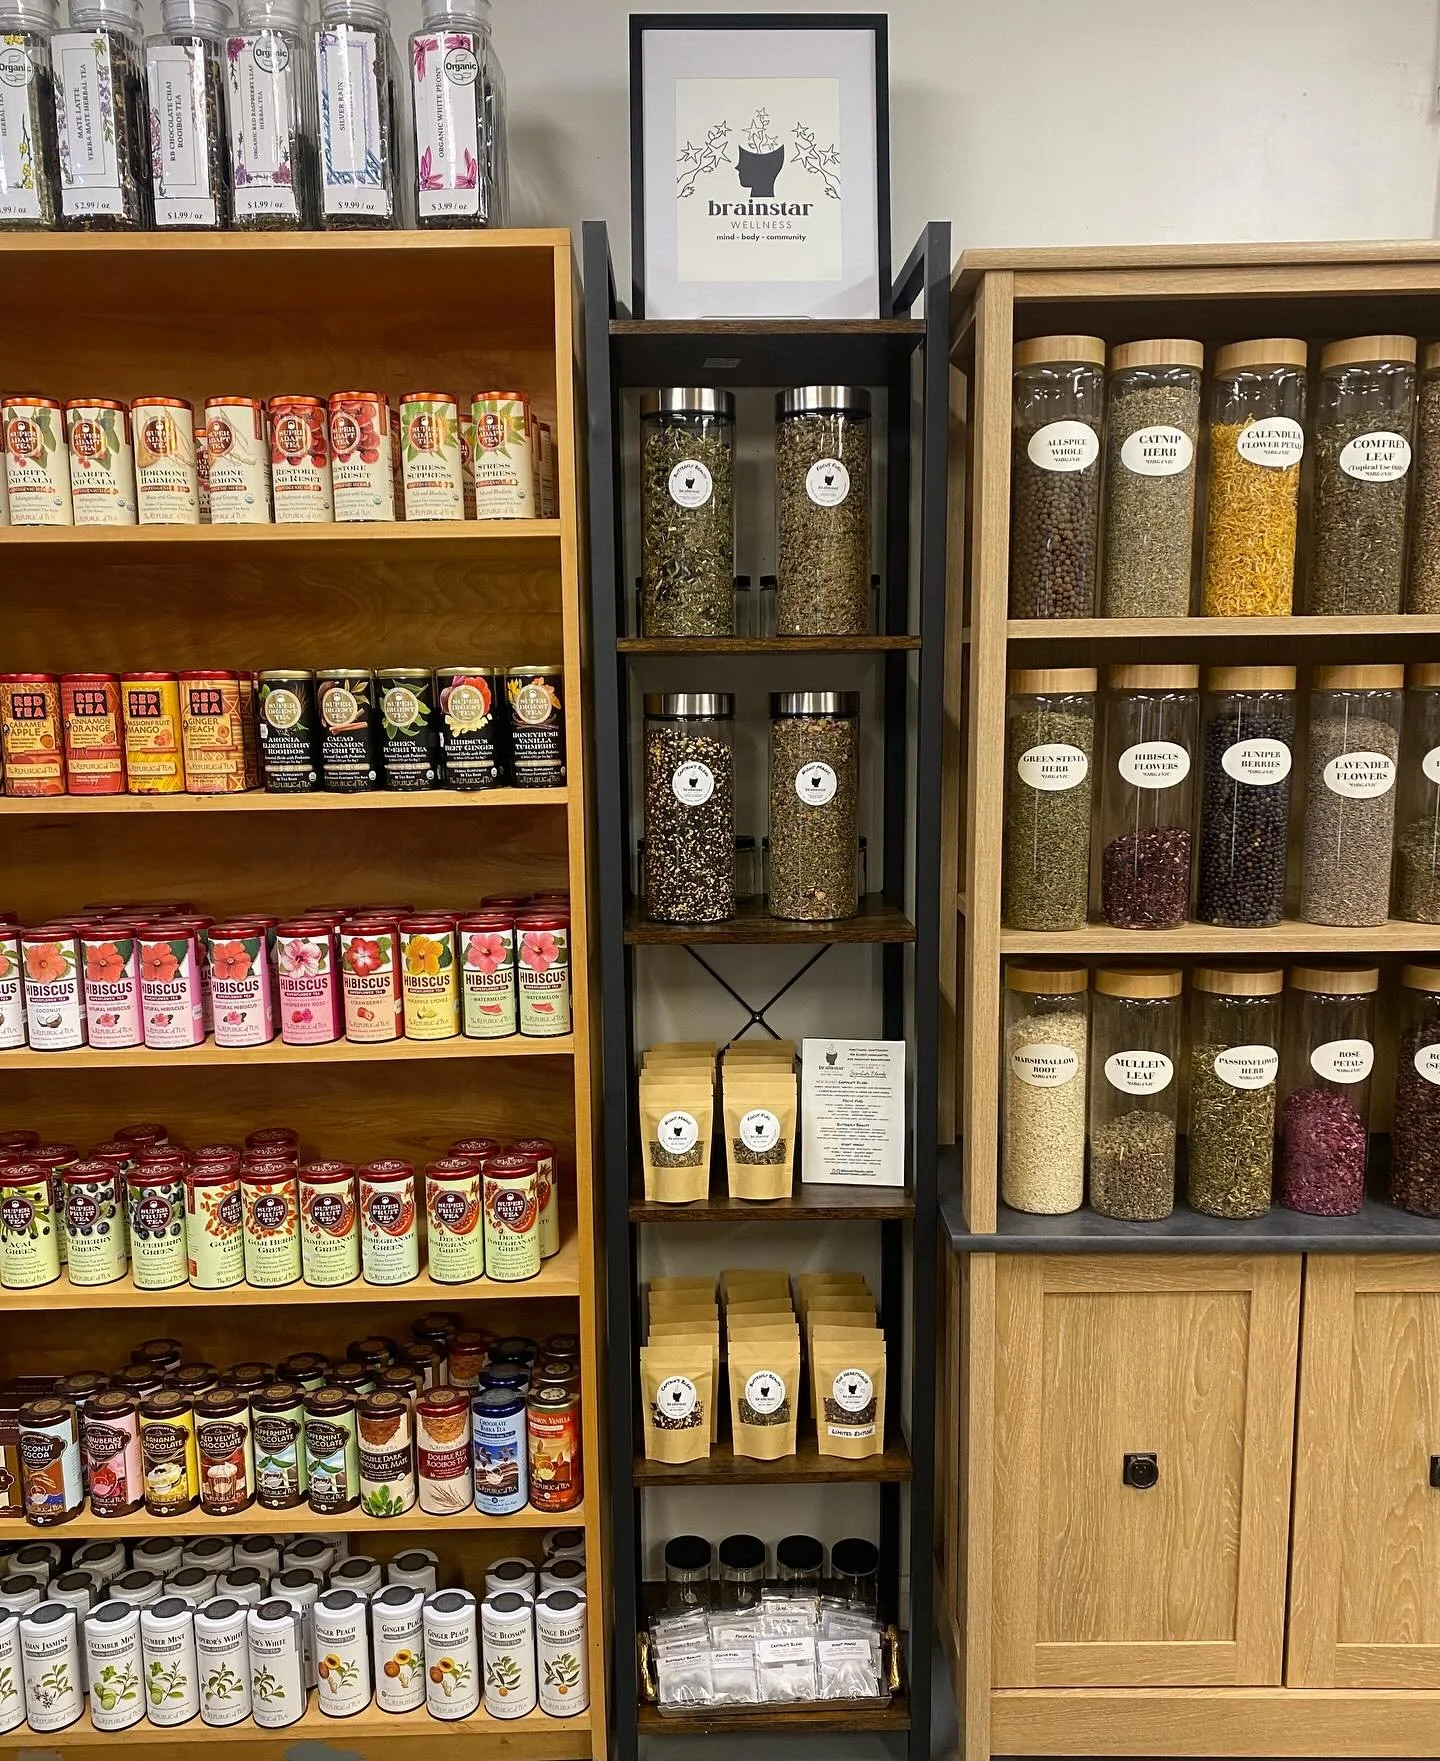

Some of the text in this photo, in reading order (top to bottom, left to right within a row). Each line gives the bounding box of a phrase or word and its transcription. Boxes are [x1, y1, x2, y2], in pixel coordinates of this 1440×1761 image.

[446, 62, 477, 71] Organic
[434, 67, 442, 92] PEONY
[74, 87, 82, 114] LATTE
[82, 81, 90, 113] HERBAL
[165, 81, 176, 162] RB CHOCOLATE CHAI
[176, 112, 184, 149] ROOIBOS
[437, 121, 445, 159] ORGANIC
[708, 199, 814, 216] brainstar
[731, 221, 792, 229] WELLNESS
[741, 233, 760, 242] body
[767, 234, 807, 242] community
[1139, 435, 1182, 444] CATNIP
[1247, 430, 1301, 440] CALENDULA
[1047, 439, 1088, 447] ALLSPICE
[1241, 441, 1280, 449] FLOWER
[1353, 439, 1405, 449] COMFREY
[1051, 448, 1083, 456] WHOLE
[1143, 448, 1177, 457] HERB
[1366, 452, 1395, 461] LEAF
[407, 471, 452, 479] SUPPRESS
[141, 477, 189, 485] HARMONY
[13, 695, 43, 706] RED
[75, 692, 105, 703] RED
[130, 694, 159, 704] RED
[191, 692, 220, 702] RED
[14, 706, 44, 717] TEA
[76, 704, 106, 714] TEA
[130, 705, 160, 715] TEA
[192, 703, 221, 714] TEA
[10, 728, 41, 737] APPLE
[1055, 755, 1085, 763] STEVIA
[1134, 753, 1179, 761] HIBISCUS
[1241, 751, 1281, 759] JUNIPER
[1042, 765, 1069, 773] HERB
[1134, 763, 1179, 771] FLOWERS
[1241, 760, 1281, 768] BERRIES
[1335, 761, 1390, 770] LAVENDER
[1337, 772, 1388, 781] FLOWERS
[404, 974, 450, 987] HIBISCUS
[466, 972, 512, 985] HIBISCUS
[520, 970, 566, 984] HIBISCUS
[86, 982, 132, 995] HIBISCUS
[212, 980, 260, 993] HIBISCUS
[280, 977, 328, 991] HIBISCUS
[344, 977, 390, 990] HIBISCUS
[26, 982, 75, 997] HIBISCUS
[142, 982, 187, 996] HIBISCUS
[1015, 1056, 1074, 1065] MARSHMALLOW
[1115, 1058, 1166, 1069] MULLEIN
[1333, 1059, 1364, 1067] PETALS
[1127, 1071, 1155, 1080] LEAF
[270, 1235, 298, 1245] BERRY
[258, 1245, 289, 1254] GREEN
[214, 1433, 240, 1441] VELVET
[832, 1427, 873, 1437] LIMITED EDITION
[145, 1436, 176, 1444] BANANA
[200, 1439, 242, 1450] CHOCOLATE
[21, 1443, 54, 1452] COCONUT
[428, 1449, 467, 1461] DOUBLE RED
[426, 1456, 468, 1468] ROOIBOS TEA
[316, 1624, 356, 1637] GINGER PEACH
[382, 1624, 405, 1632] GINGER
[560, 1624, 584, 1637] BLOSSOM
[121, 1633, 137, 1644] MINT
[427, 1627, 470, 1640] GINGER PEACH
[42, 1636, 68, 1651] JASMINE
